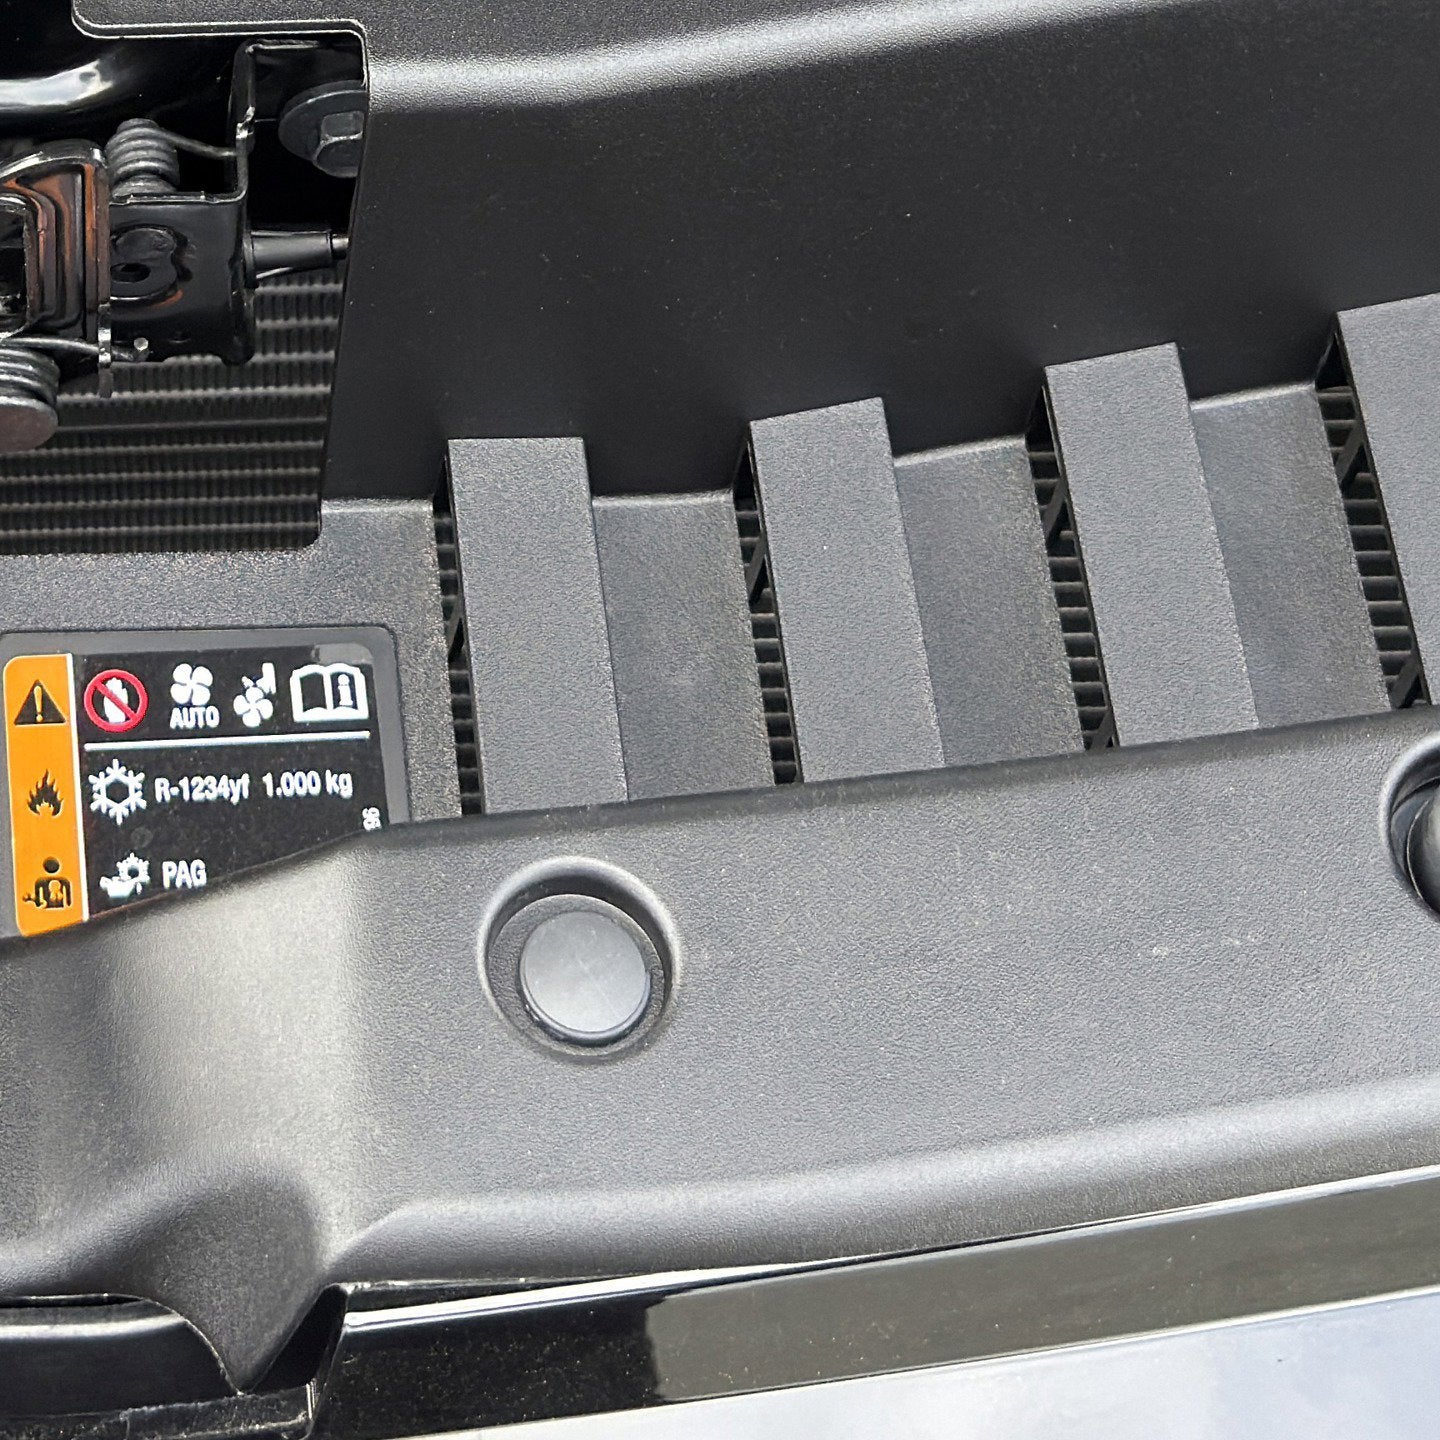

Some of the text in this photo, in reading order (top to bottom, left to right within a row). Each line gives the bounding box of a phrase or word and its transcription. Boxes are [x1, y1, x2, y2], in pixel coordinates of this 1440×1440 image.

[169, 704, 220, 730] AUTO
[154, 769, 354, 805] R-1234yf 1.000 kg
[161, 859, 208, 889] PAG
